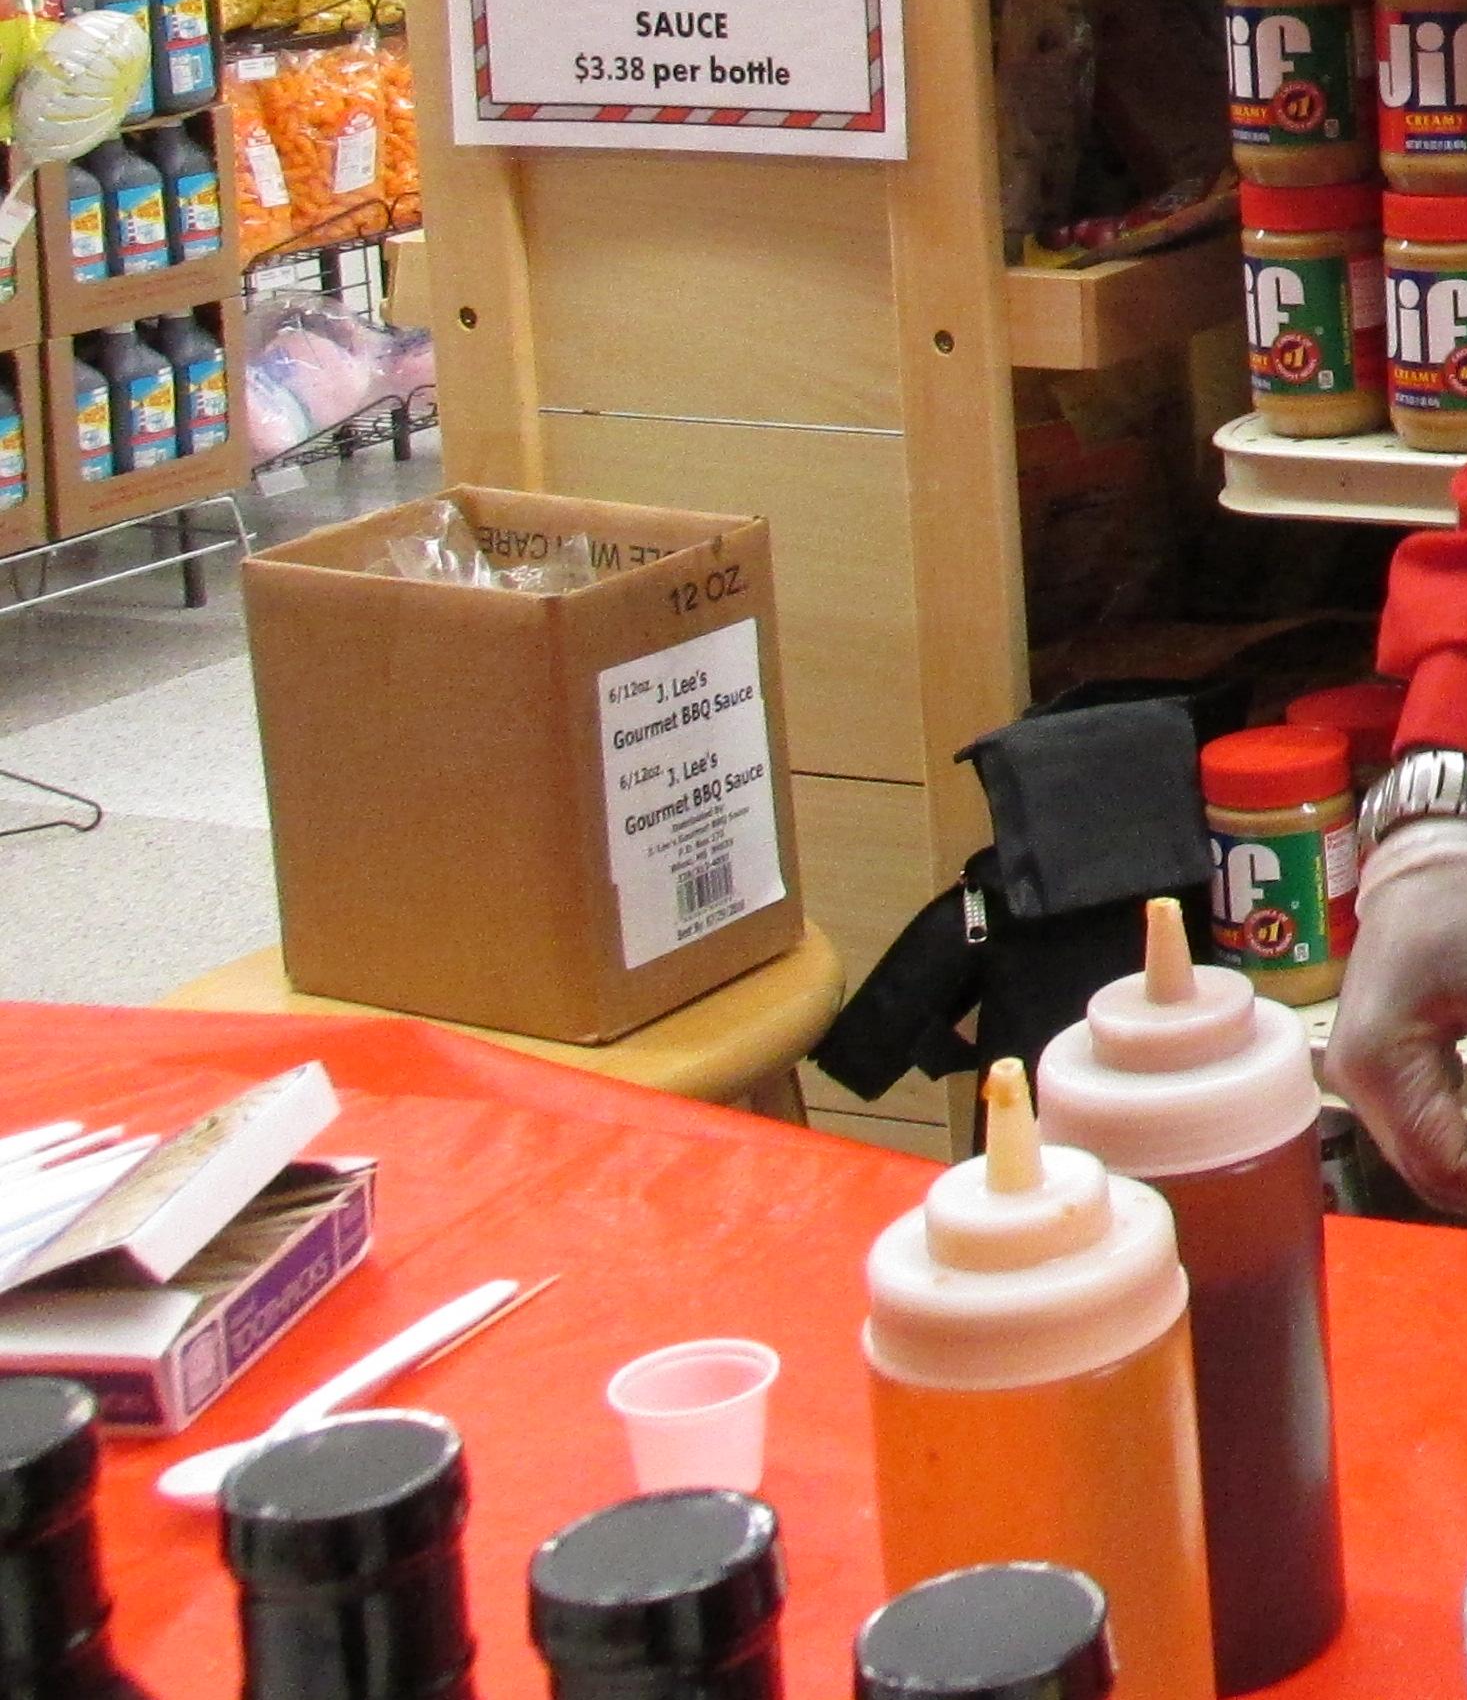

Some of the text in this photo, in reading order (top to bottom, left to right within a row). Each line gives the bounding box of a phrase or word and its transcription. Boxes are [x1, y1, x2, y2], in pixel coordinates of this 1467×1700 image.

[635, 10, 729, 39] SAUCE
[573, 52, 791, 88] $3.38 per bottle
[1227, 15, 1312, 99] if
[1405, 113, 1464, 126] CREAMY
[1245, 265, 1305, 347] if
[668, 564, 741, 615] 12 OZ
[673, 670, 708, 698] Lee's
[614, 685, 754, 750] Gourmet BBQ Sauce
[683, 750, 718, 780] Lee's
[625, 794, 690, 836] Gourmet
[693, 779, 722, 807] BBQ
[726, 763, 764, 793] Sauce
[1211, 841, 1281, 928] if
[1256, 918, 1282, 942] #1
